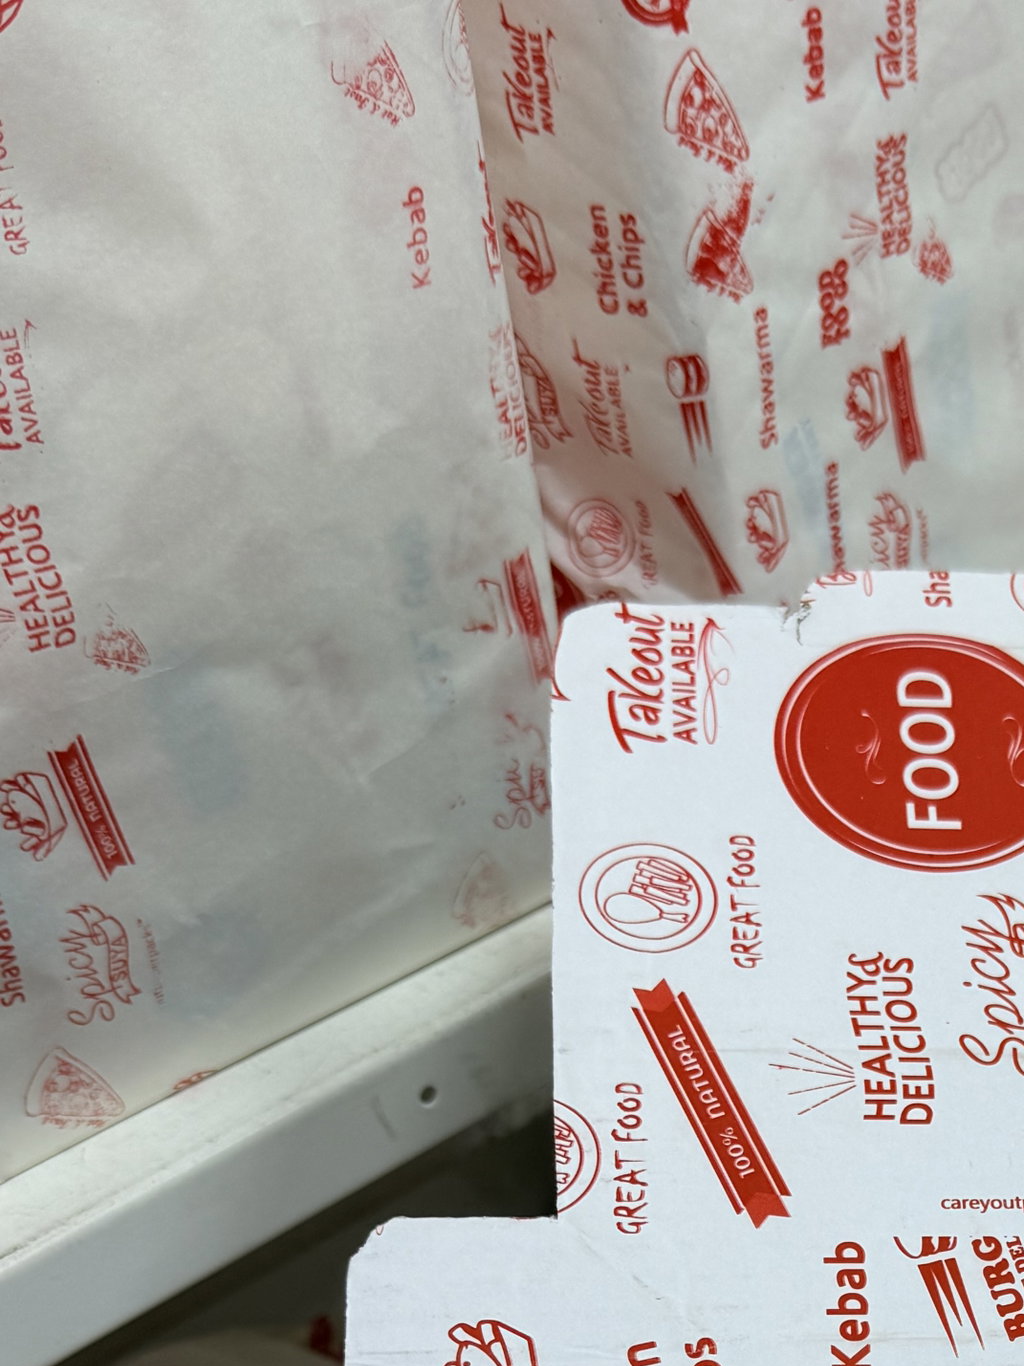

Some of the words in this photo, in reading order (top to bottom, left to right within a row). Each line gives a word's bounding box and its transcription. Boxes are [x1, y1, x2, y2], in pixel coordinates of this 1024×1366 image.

[801, 8, 826, 104] Kebab
[875, 0, 905, 102] Takeou
[904, 0, 918, 83] AVAILAB
[0, 186, 29, 256] GREA
[401, 185, 431, 290] Kebab
[589, 202, 620, 316] Chicken
[619, 211, 648, 292] Chips
[1, 327, 45, 446] AVAILABLE
[753, 307, 779, 449] Shawarma
[16, 504, 77, 649] DELICIOUS
[666, 618, 698, 746] AVAILABLE
[897, 669, 962, 831] FOOD
[729, 834, 760, 893] FOOD
[57, 927, 122, 1027] Spicy
[107, 934, 129, 994] SUYA
[730, 893, 764, 970] GREAT
[887, 956, 935, 1126] DELICIOUS
[611, 1081, 649, 1142] FOOD
[718, 1127, 756, 1181] 100%
[613, 1149, 649, 1235] GREAT
